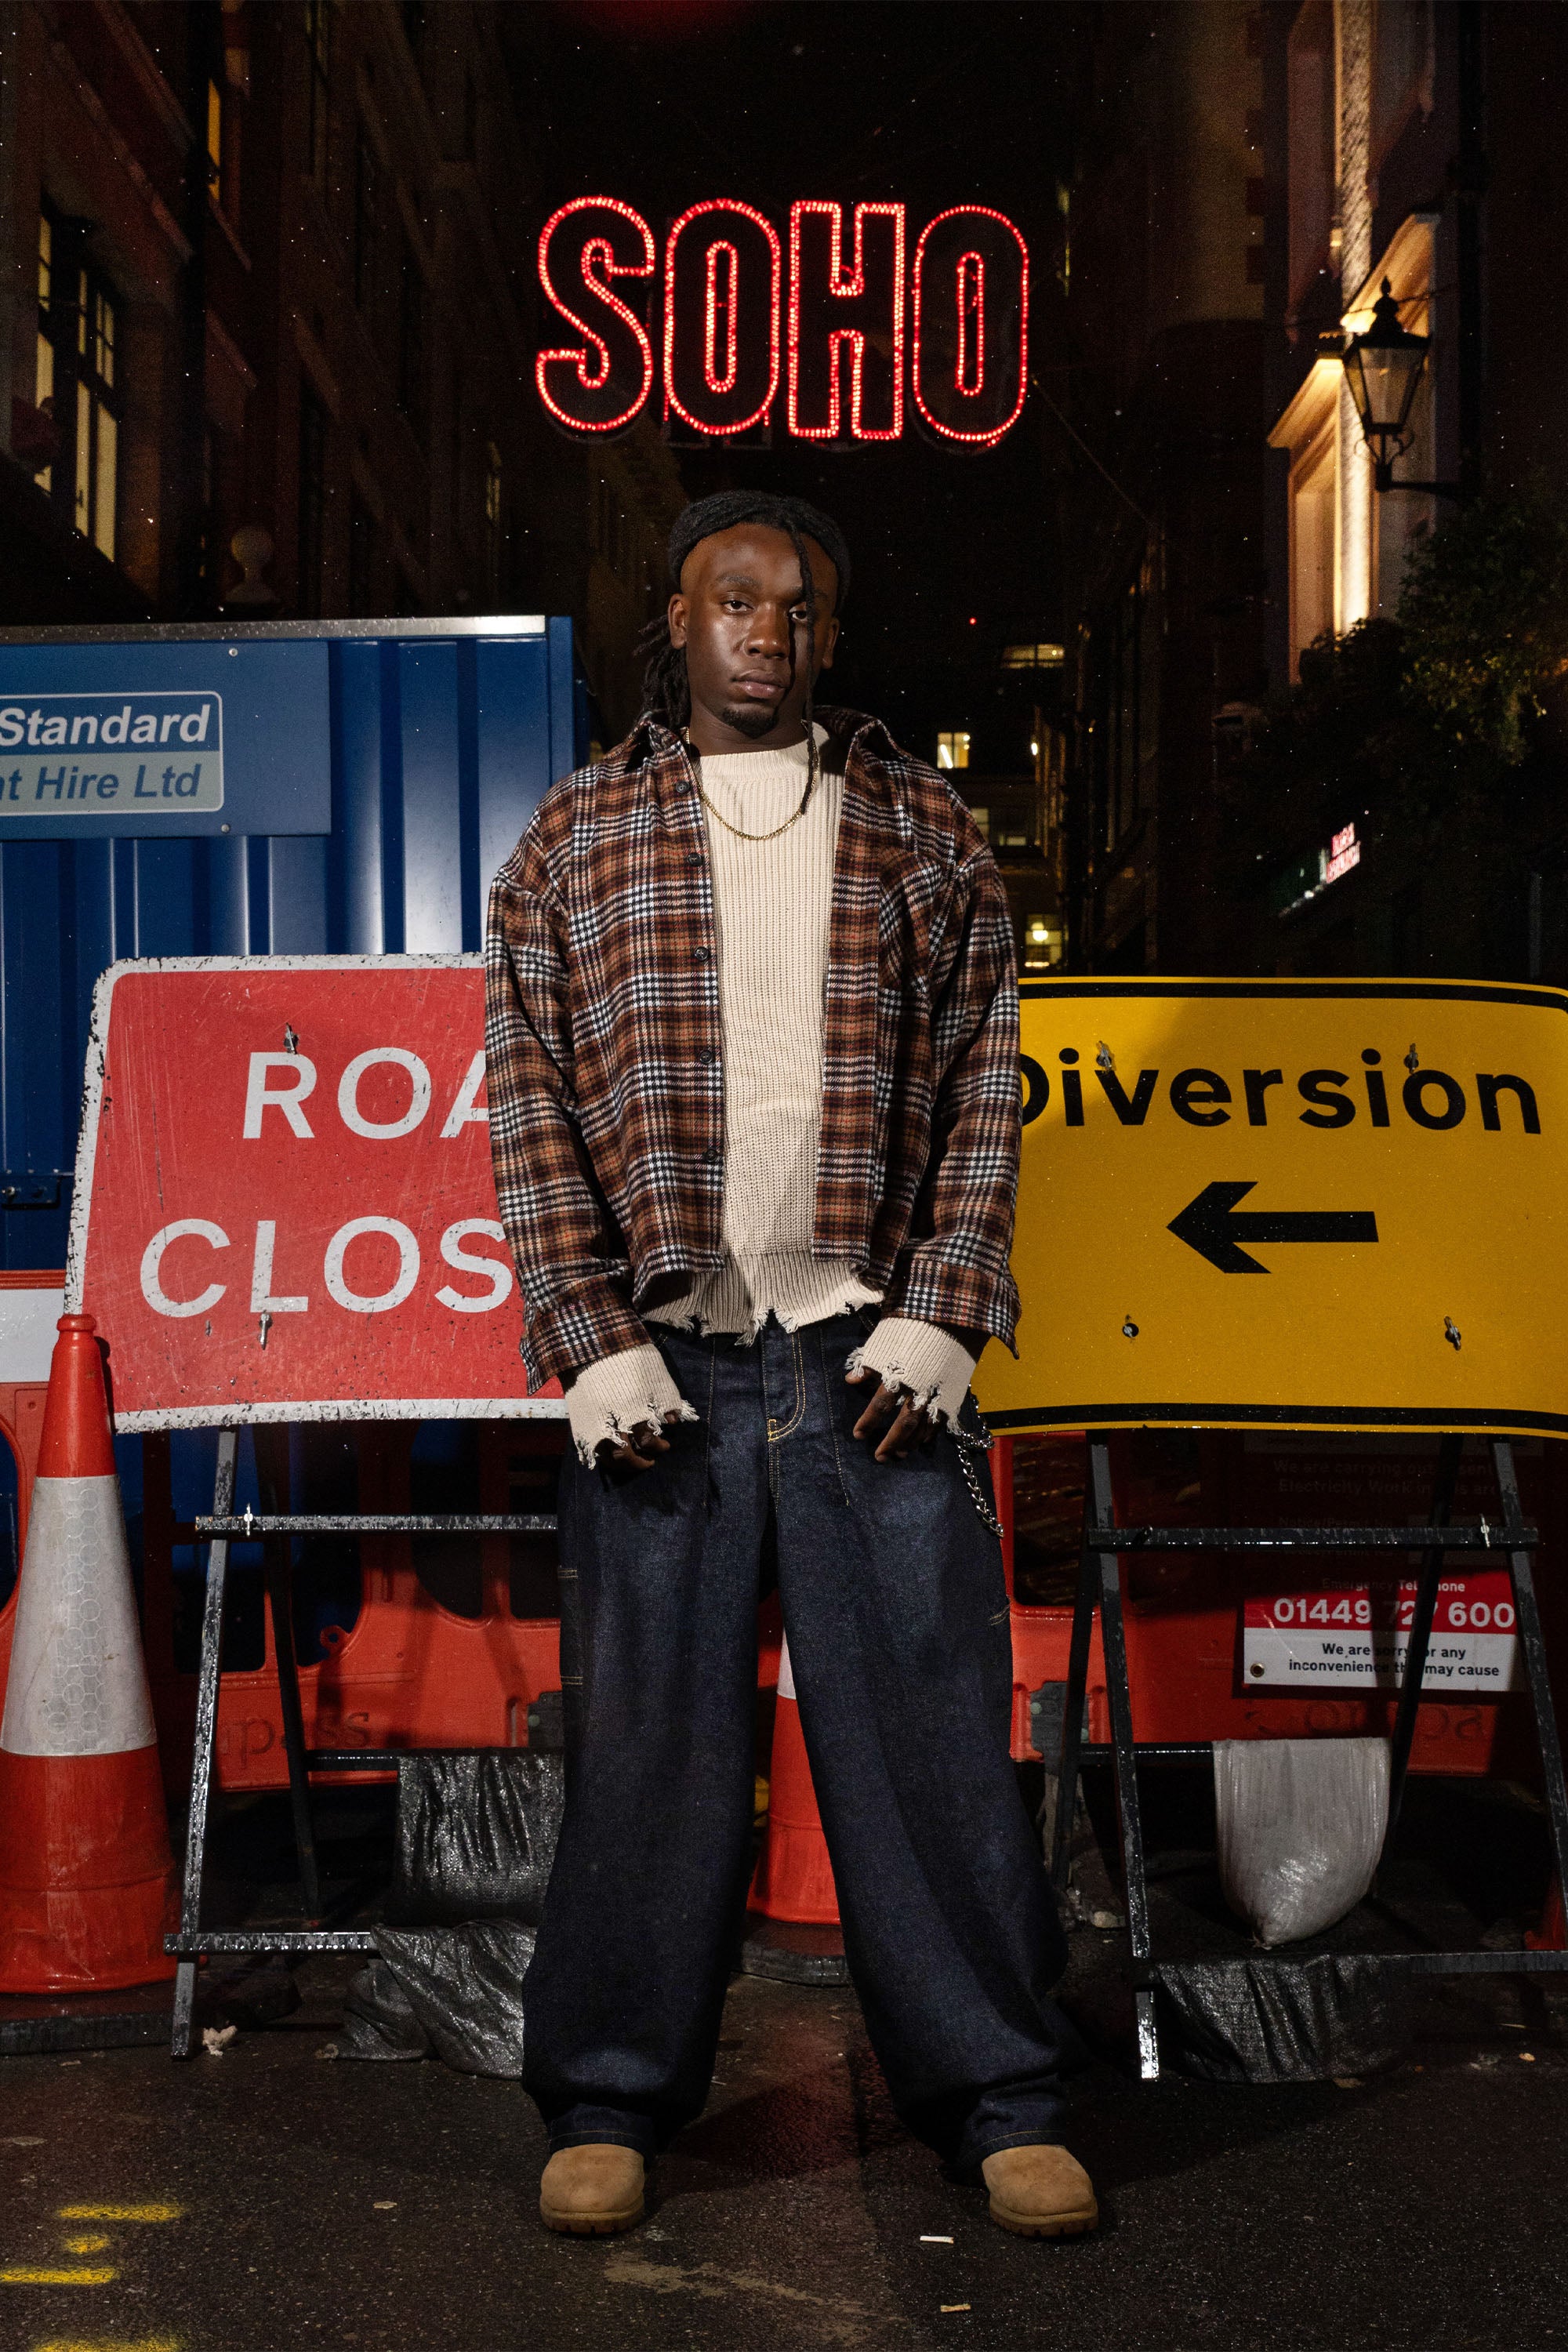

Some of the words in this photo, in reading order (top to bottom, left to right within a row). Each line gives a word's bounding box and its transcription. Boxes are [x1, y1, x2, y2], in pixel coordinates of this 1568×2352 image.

[535, 194, 1030, 443] SOHO
[0, 704, 210, 746] Standard
[35, 765, 118, 800] Hire
[134, 763, 201, 798] Ltd
[242, 1047, 490, 1139] ROA
[140, 1215, 513, 1318] CLOS
[1273, 1597, 1371, 1624] 01449
[1448, 1602, 1515, 1628] 600
[1289, 1659, 1389, 1674] inconvenience
[1425, 1665, 1454, 1676] may
[1458, 1666, 1500, 1676] cause
[1322, 1642, 1344, 1655] We
[1348, 1645, 1370, 1656] are
[1441, 1648, 1466, 1659] any
